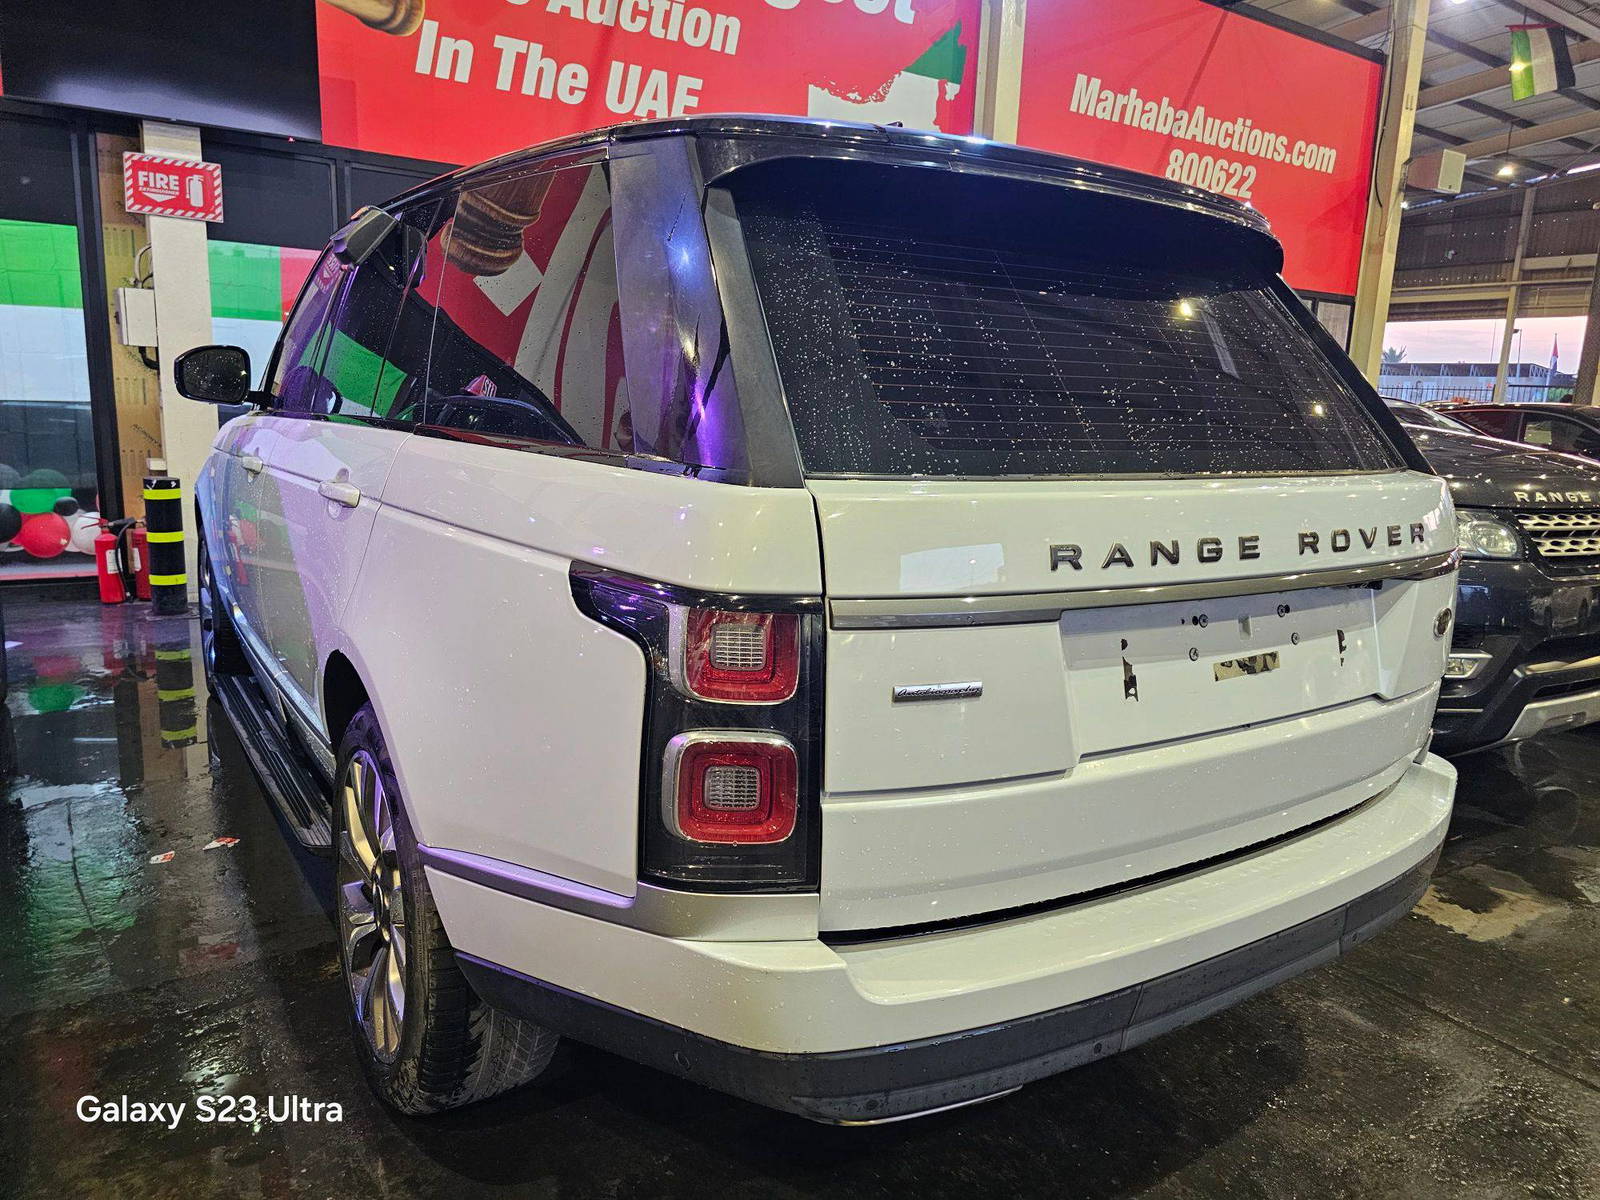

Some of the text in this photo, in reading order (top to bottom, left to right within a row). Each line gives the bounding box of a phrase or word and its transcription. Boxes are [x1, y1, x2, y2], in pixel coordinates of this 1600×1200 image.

[414, 19, 475, 84] In
[493, 34, 590, 106] The
[1069, 73, 1337, 174] MarhabaAuctions.com
[137, 170, 180, 191] FIRE
[1165, 149, 1257, 199] 800622
[1512, 491, 1592, 503] RANGE
[1050, 523, 1425, 571] RANGE ROVER
